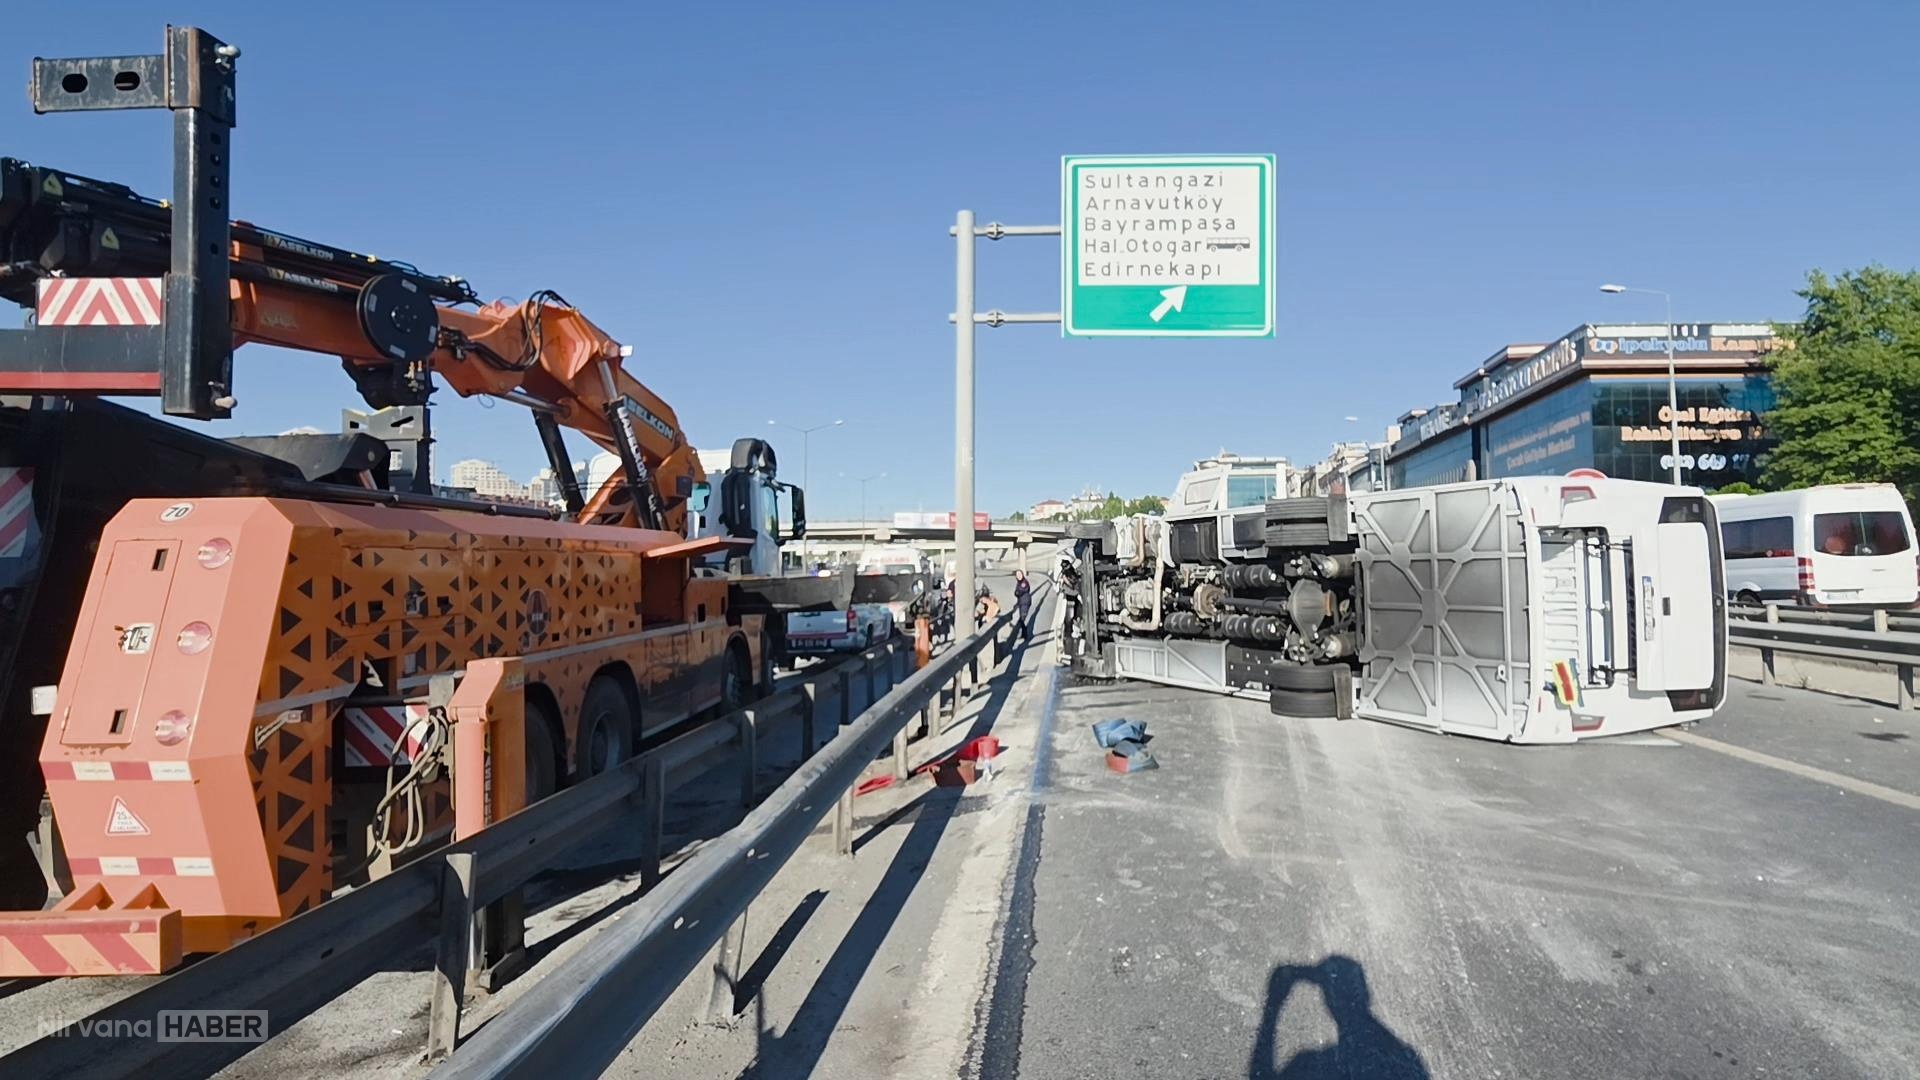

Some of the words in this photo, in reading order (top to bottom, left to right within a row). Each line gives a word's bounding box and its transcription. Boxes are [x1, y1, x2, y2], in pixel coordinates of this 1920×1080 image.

[1085, 171, 1223, 192] Sultangazi
[1085, 195, 1223, 213] Arnavutköy
[1085, 217, 1236, 234] Bayrampaşa
[1085, 261, 1221, 280] Edirnekapı
[165, 506, 190, 518] 70
